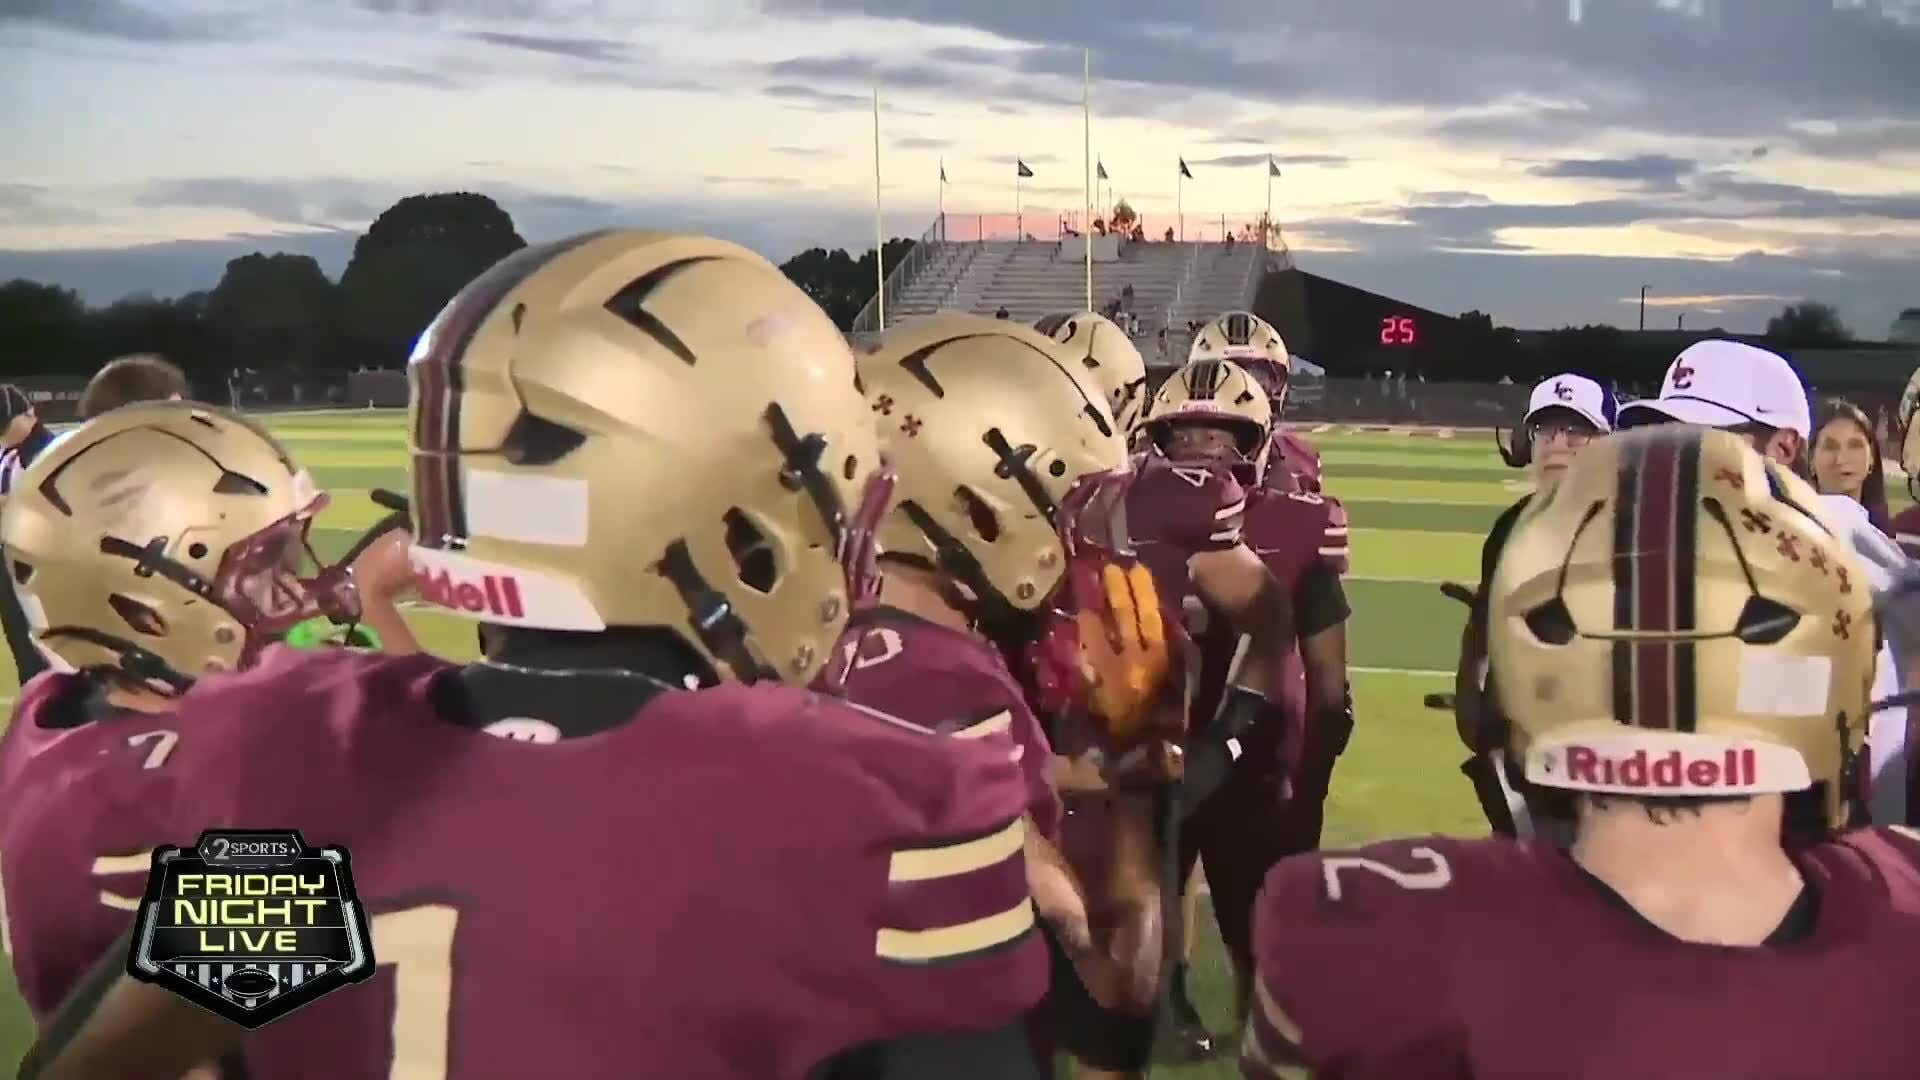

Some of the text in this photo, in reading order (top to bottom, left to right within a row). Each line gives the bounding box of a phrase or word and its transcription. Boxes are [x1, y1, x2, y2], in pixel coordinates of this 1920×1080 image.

[1381, 318, 1414, 343] 25
[128, 730, 178, 770] 7
[1566, 746, 1757, 788] Riddell
[1321, 847, 1451, 900] 2
